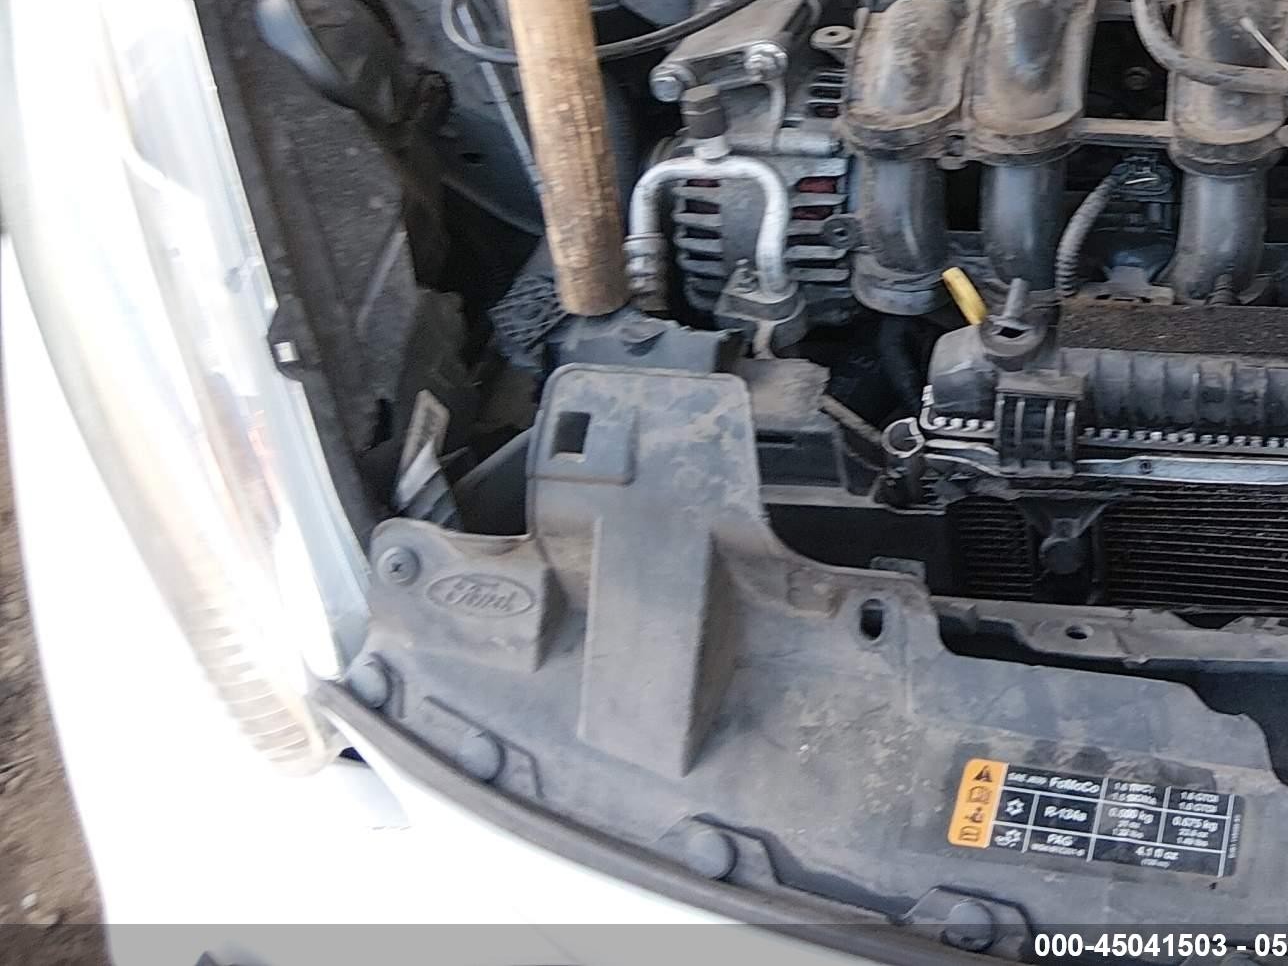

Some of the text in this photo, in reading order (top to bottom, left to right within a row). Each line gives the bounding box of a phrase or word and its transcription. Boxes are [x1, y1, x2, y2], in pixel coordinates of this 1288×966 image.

[445, 578, 518, 612] Ford
[1049, 777, 1101, 794] FoMoCo
[1138, 810, 1154, 824] kg
[1202, 819, 1218, 832] kg
